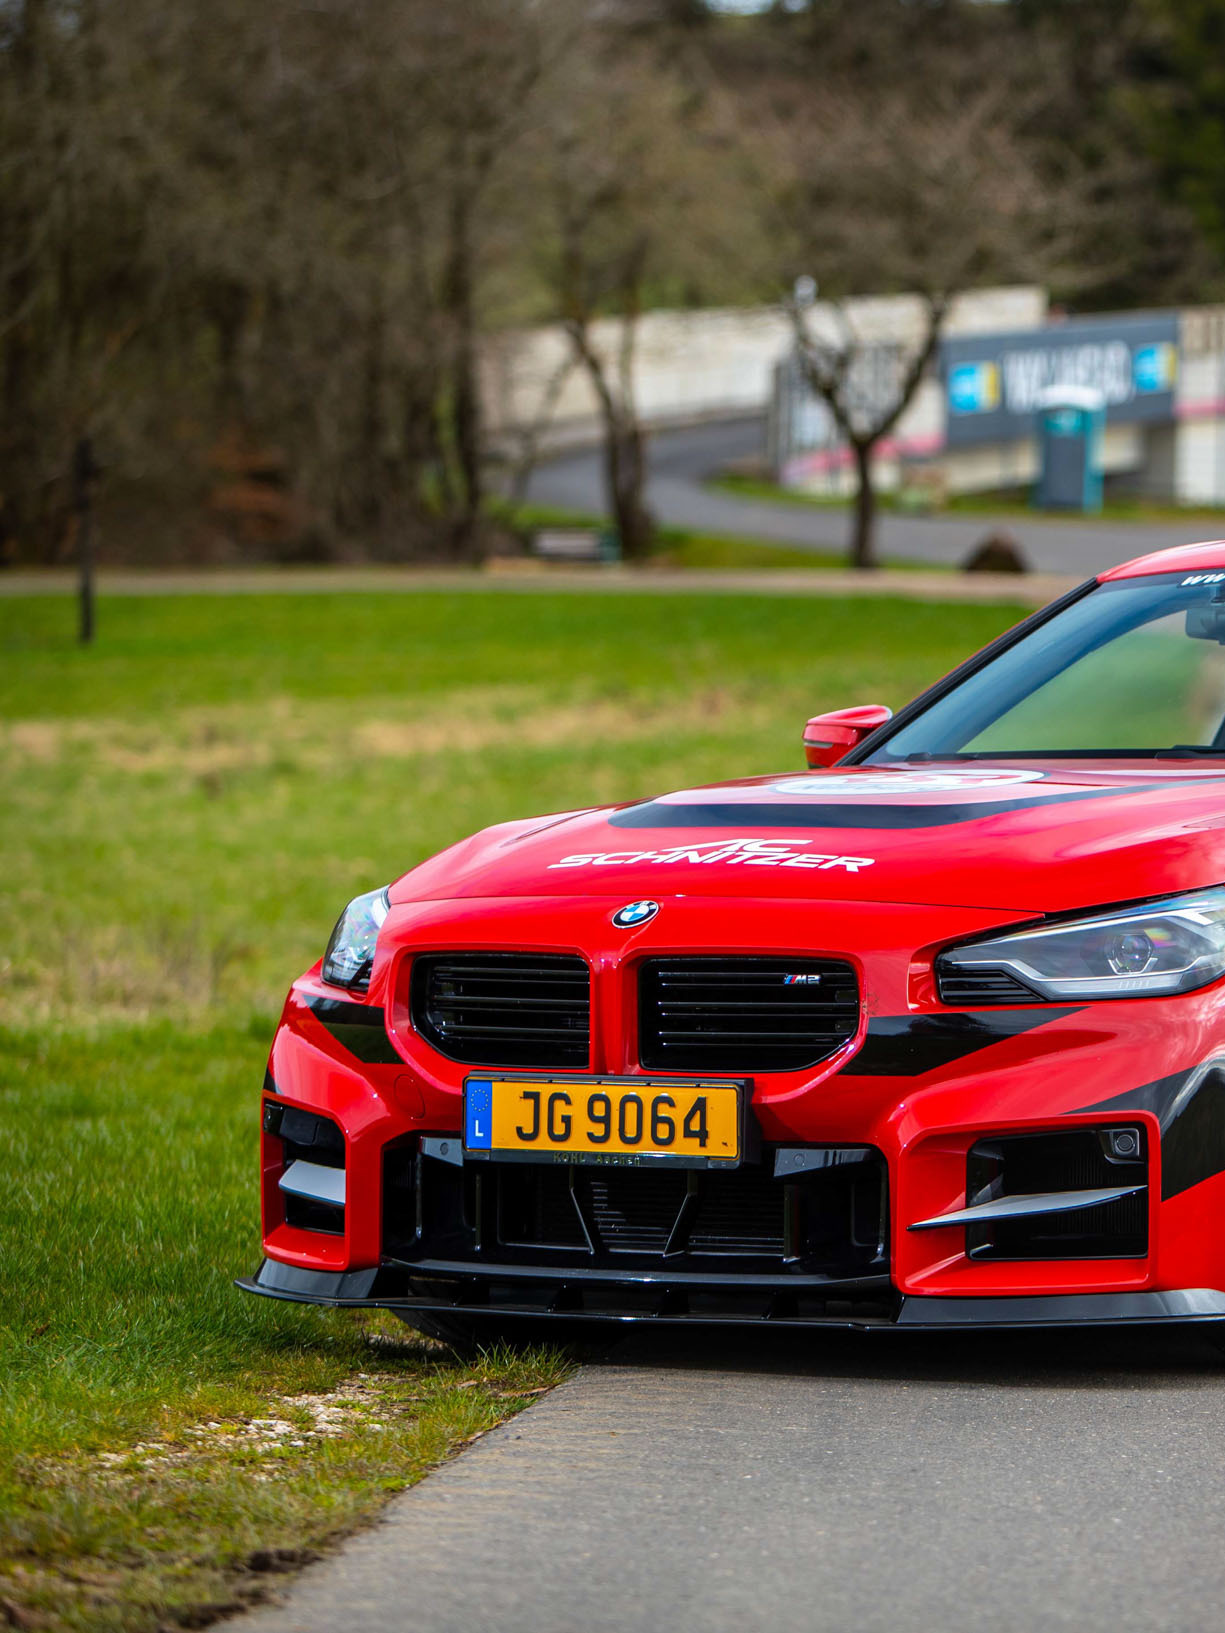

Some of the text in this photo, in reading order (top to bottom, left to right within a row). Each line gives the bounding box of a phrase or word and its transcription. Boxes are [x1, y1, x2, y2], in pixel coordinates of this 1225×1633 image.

[660, 838, 813, 853] AC
[547, 850, 875, 873] SCHNITZER
[474, 1119, 484, 1137] L
[515, 1090, 709, 1148] JG 9064
